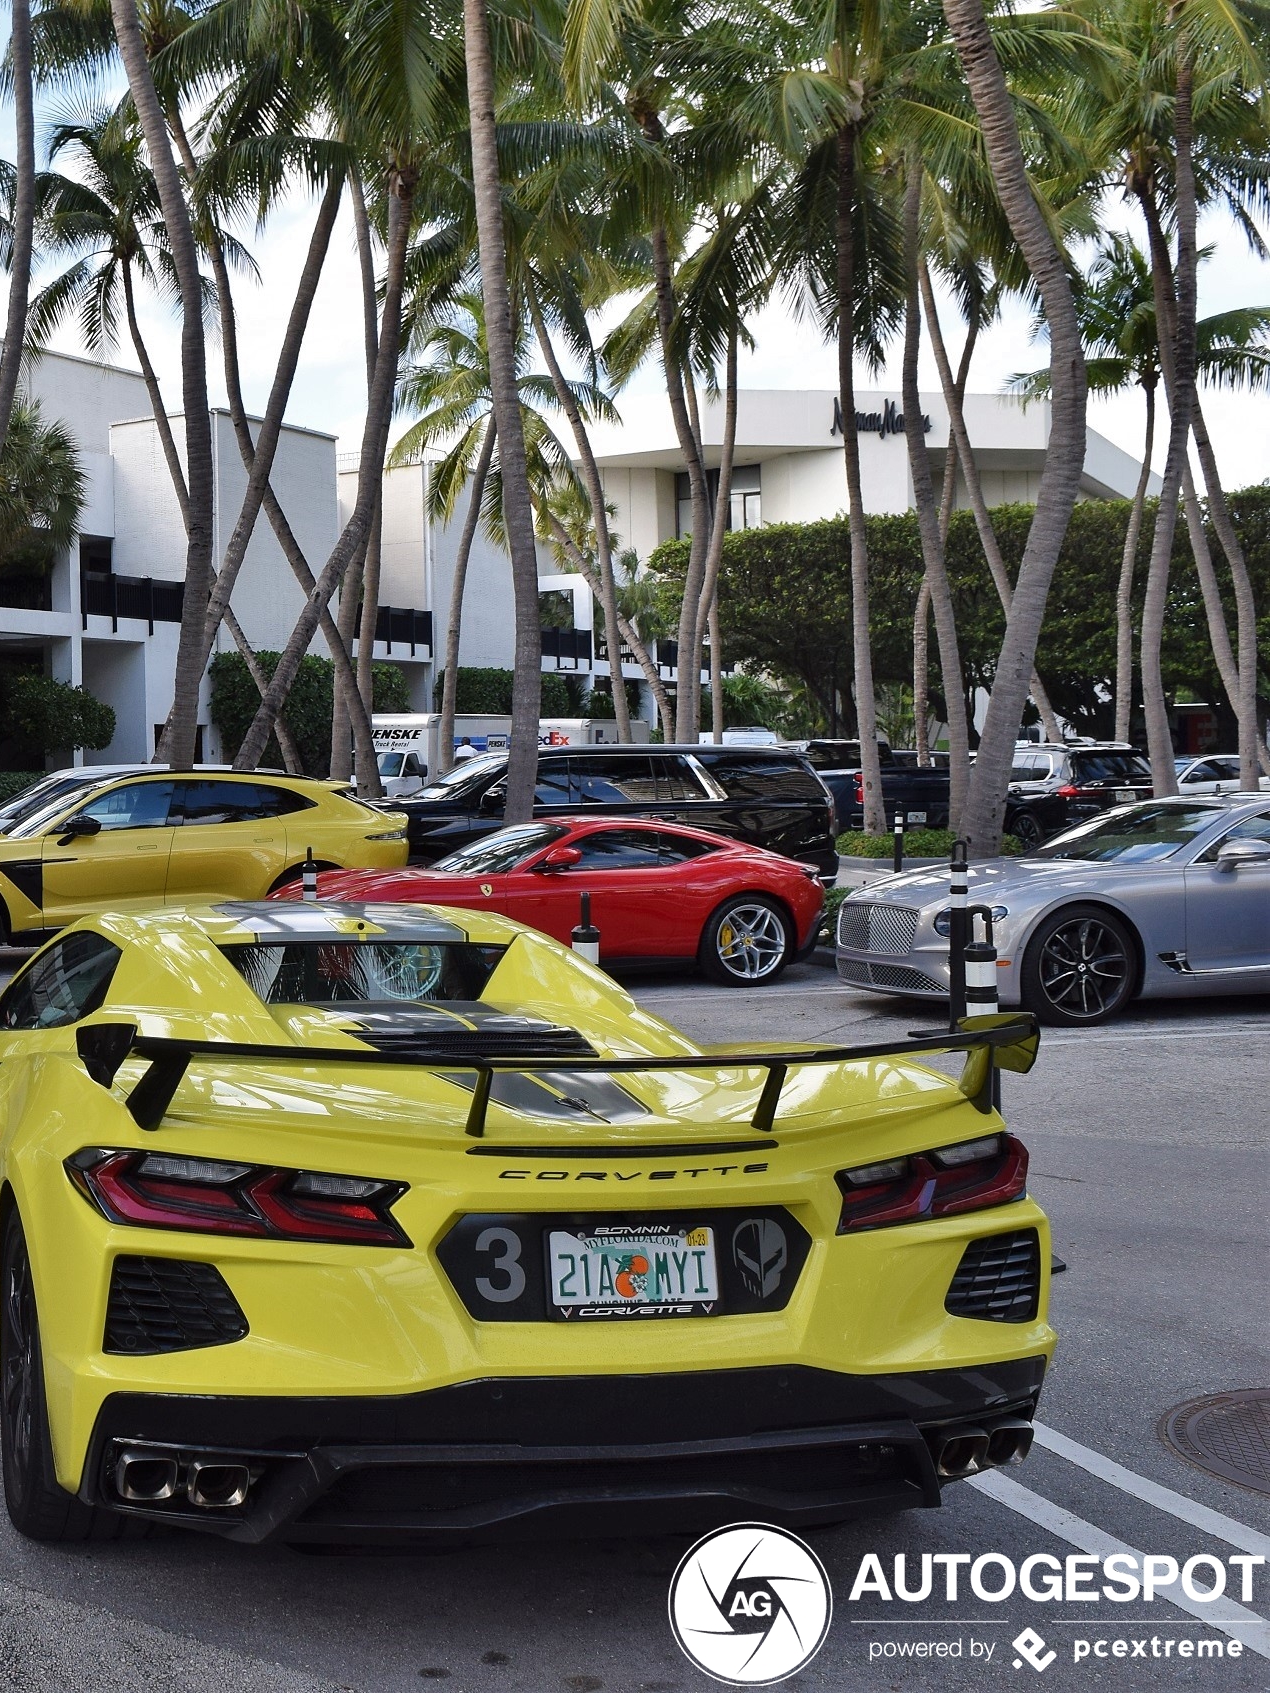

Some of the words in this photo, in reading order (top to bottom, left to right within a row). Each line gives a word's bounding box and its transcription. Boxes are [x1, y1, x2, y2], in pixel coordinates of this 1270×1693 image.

[831, 397, 881, 435] Nman
[488, 740, 506, 748] PENSKE
[538, 731, 570, 746] edEx
[498, 1163, 769, 1181] CORVETTE
[583, 1235, 679, 1250] MYFLORIDA.COM
[687, 1233, 706, 1247] 01-23
[475, 1227, 526, 1303] 3
[557, 1253, 615, 1297] 21A
[655, 1250, 709, 1295] MYI
[578, 1304, 694, 1317] CORVETTE
